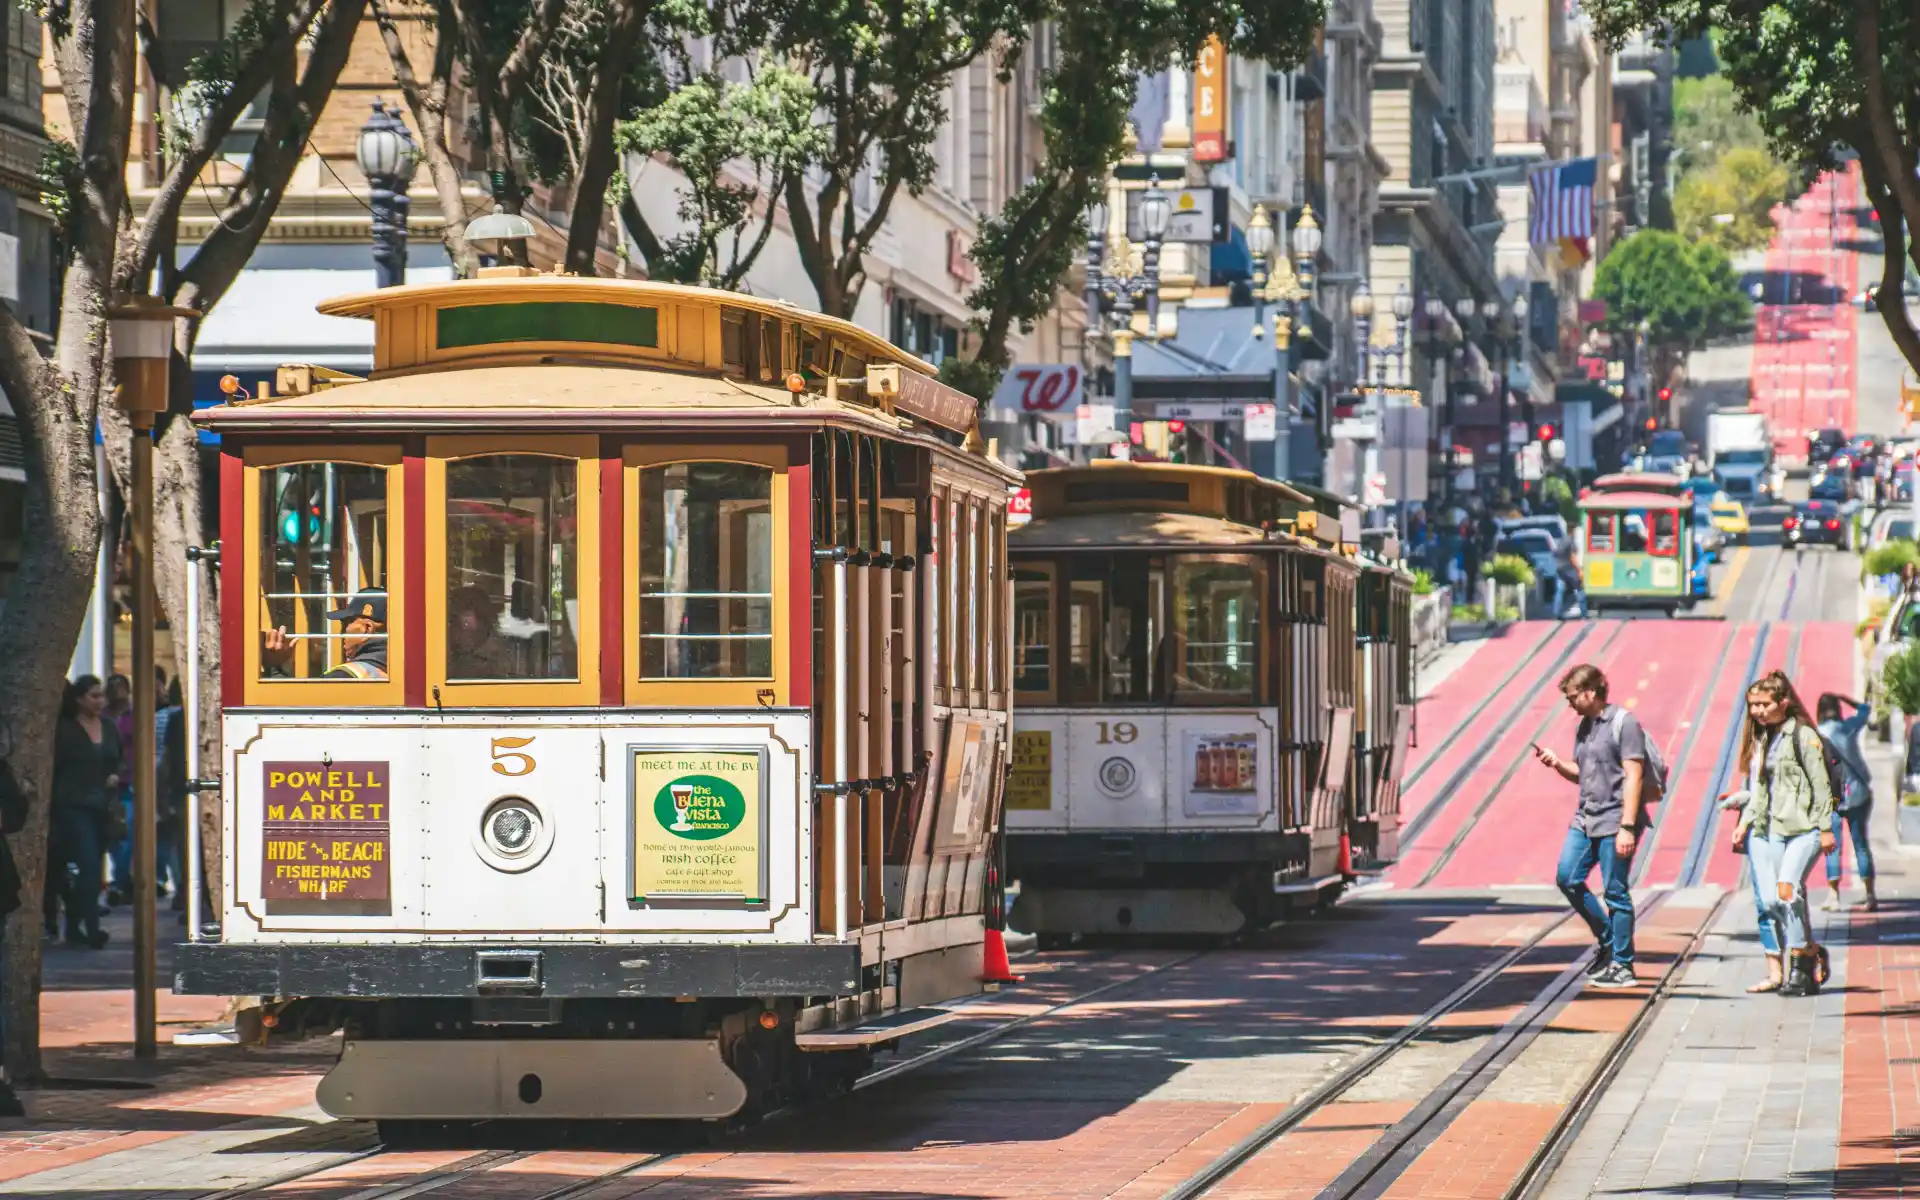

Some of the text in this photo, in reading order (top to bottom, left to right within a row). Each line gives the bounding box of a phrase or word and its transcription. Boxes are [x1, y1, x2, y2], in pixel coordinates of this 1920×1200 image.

[1095, 721, 1138, 745] 19
[491, 736, 536, 776] 5
[641, 760, 674, 770] meet
[677, 761, 697, 770] me
[700, 760, 713, 770] at
[717, 760, 738, 770] the
[269, 771, 382, 788] POWELL
[300, 789, 355, 802] AND
[693, 785, 712, 795] the
[268, 804, 384, 820] MARKET
[267, 841, 383, 861] HYDE AND BEACH
[694, 853, 737, 866] coffee
[276, 865, 372, 879] FISHERMANS
[298, 880, 348, 893] WHARF
